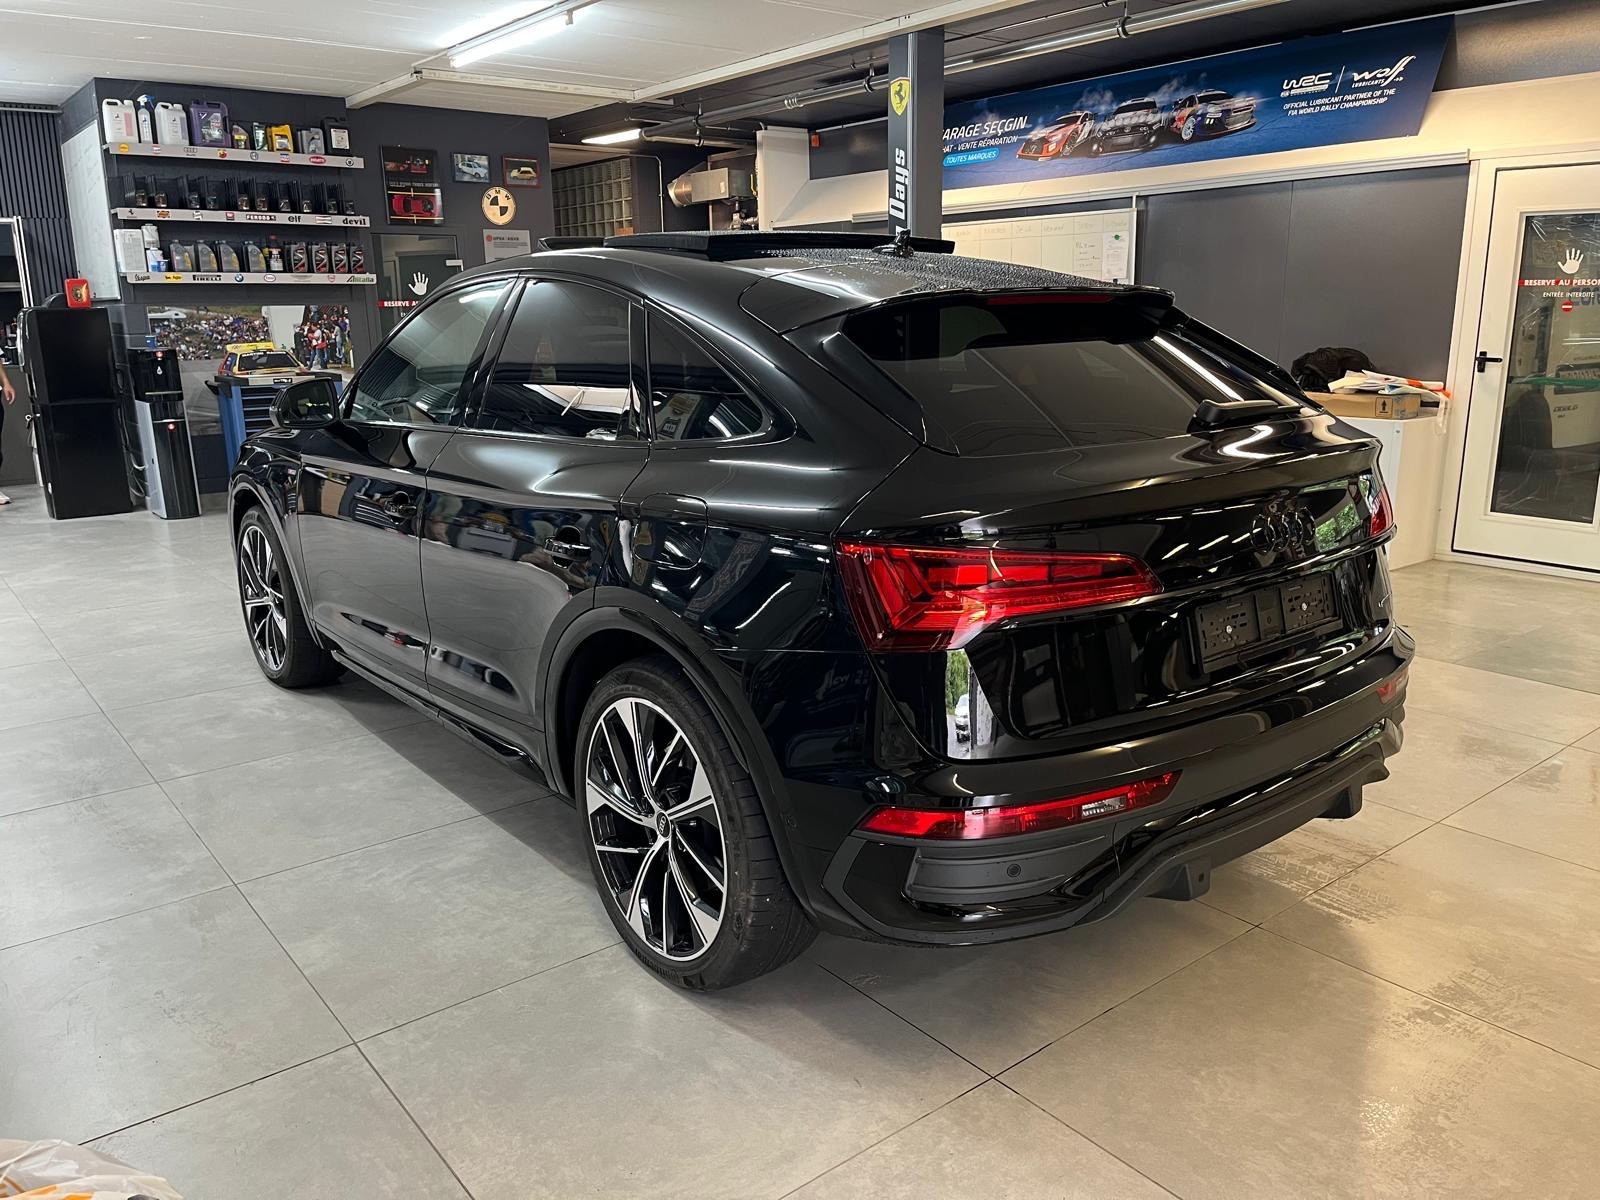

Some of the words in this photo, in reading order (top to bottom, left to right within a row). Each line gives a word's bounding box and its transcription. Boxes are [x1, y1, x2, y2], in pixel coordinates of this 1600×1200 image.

[1283, 73, 1332, 89] WRC
[1283, 101, 1308, 110] OFFICIAL
[1309, 96, 1343, 106] LUBRICANT
[1344, 92, 1372, 101] PARTNER
[1299, 106, 1320, 114] WORLD
[1321, 103, 1340, 111] RALLY
[1340, 97, 1388, 109] CHAMPIONSHIP
[943, 124, 981, 140] ARAGE
[982, 116, 1028, 136] SEÇGIN
[958, 141, 977, 151] VENTE
[978, 135, 1018, 147] RÉPARATION
[946, 154, 966, 163] TOUTES
[967, 151, 997, 160] MARQUES
[890, 148, 908, 220] Days
[1543, 290, 1564, 298] ENTRÉE
